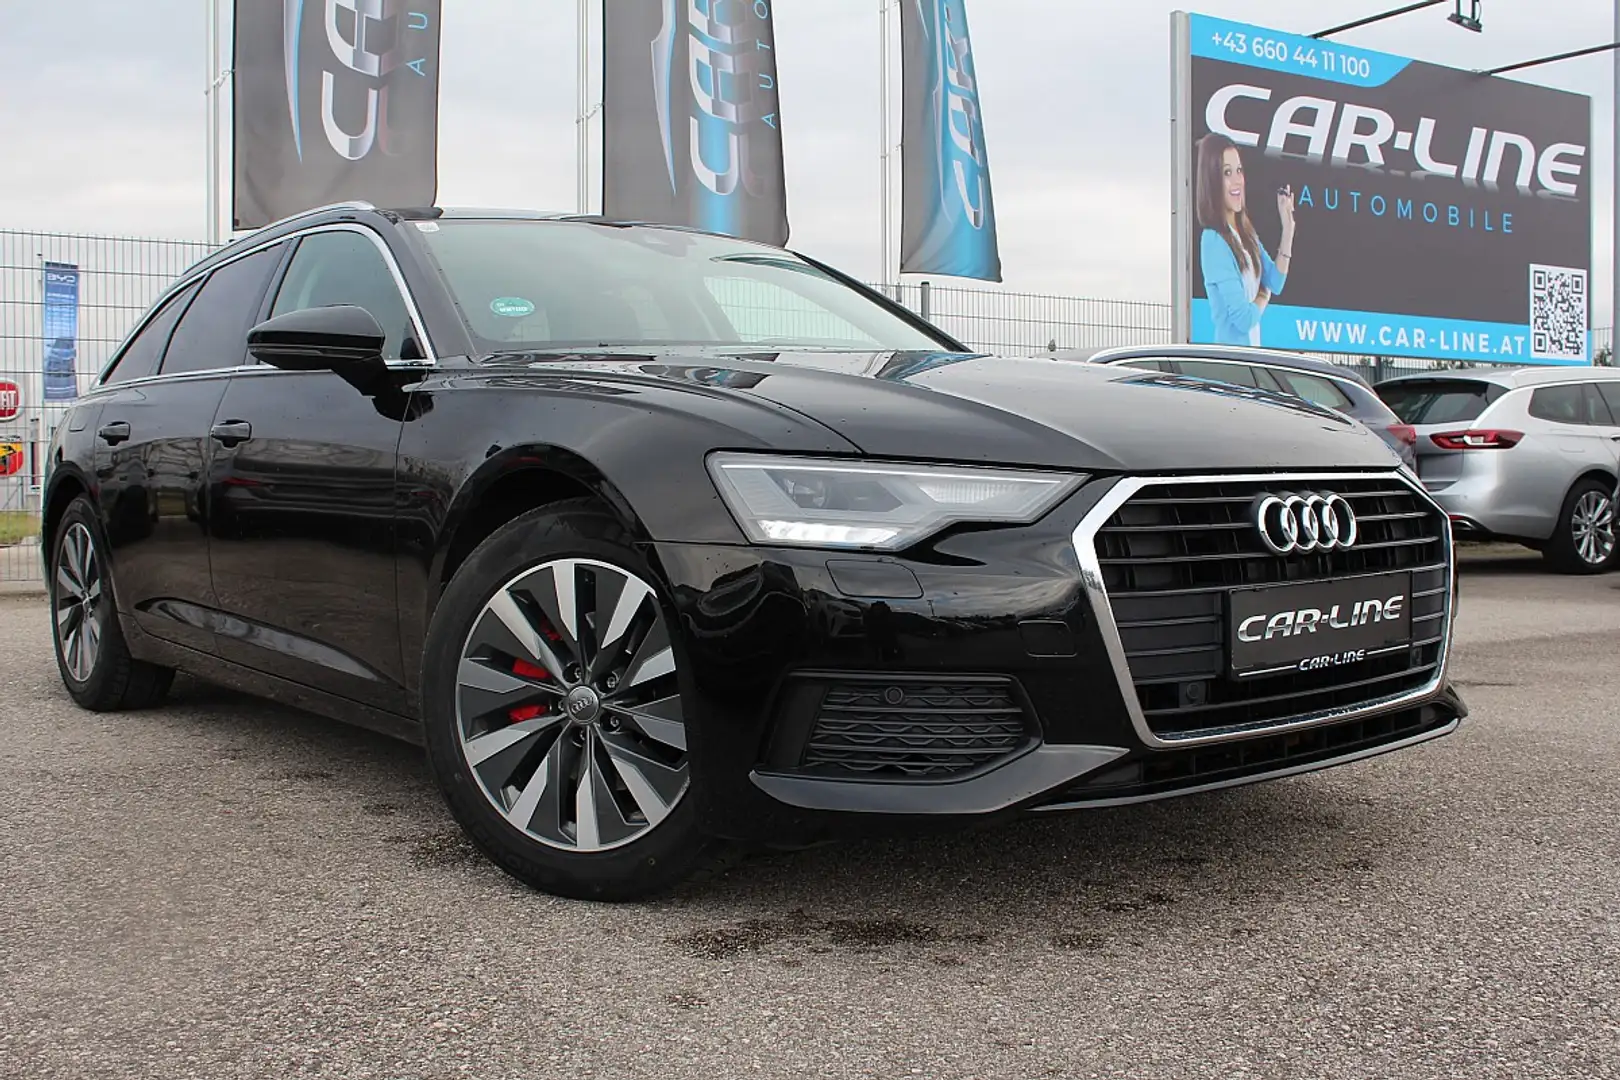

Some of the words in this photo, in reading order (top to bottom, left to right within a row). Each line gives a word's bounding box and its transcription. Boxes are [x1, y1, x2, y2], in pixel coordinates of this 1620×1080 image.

[1212, 31, 1248, 54] +43
[1252, 37, 1287, 61] 660
[1293, 46, 1318, 68] 44
[1322, 51, 1336, 72] 11
[1340, 54, 1370, 78] 100
[1299, 185, 1513, 233] AUTOMOBILE
[1297, 319, 1525, 354] WWW.CAR-LINE.AT
